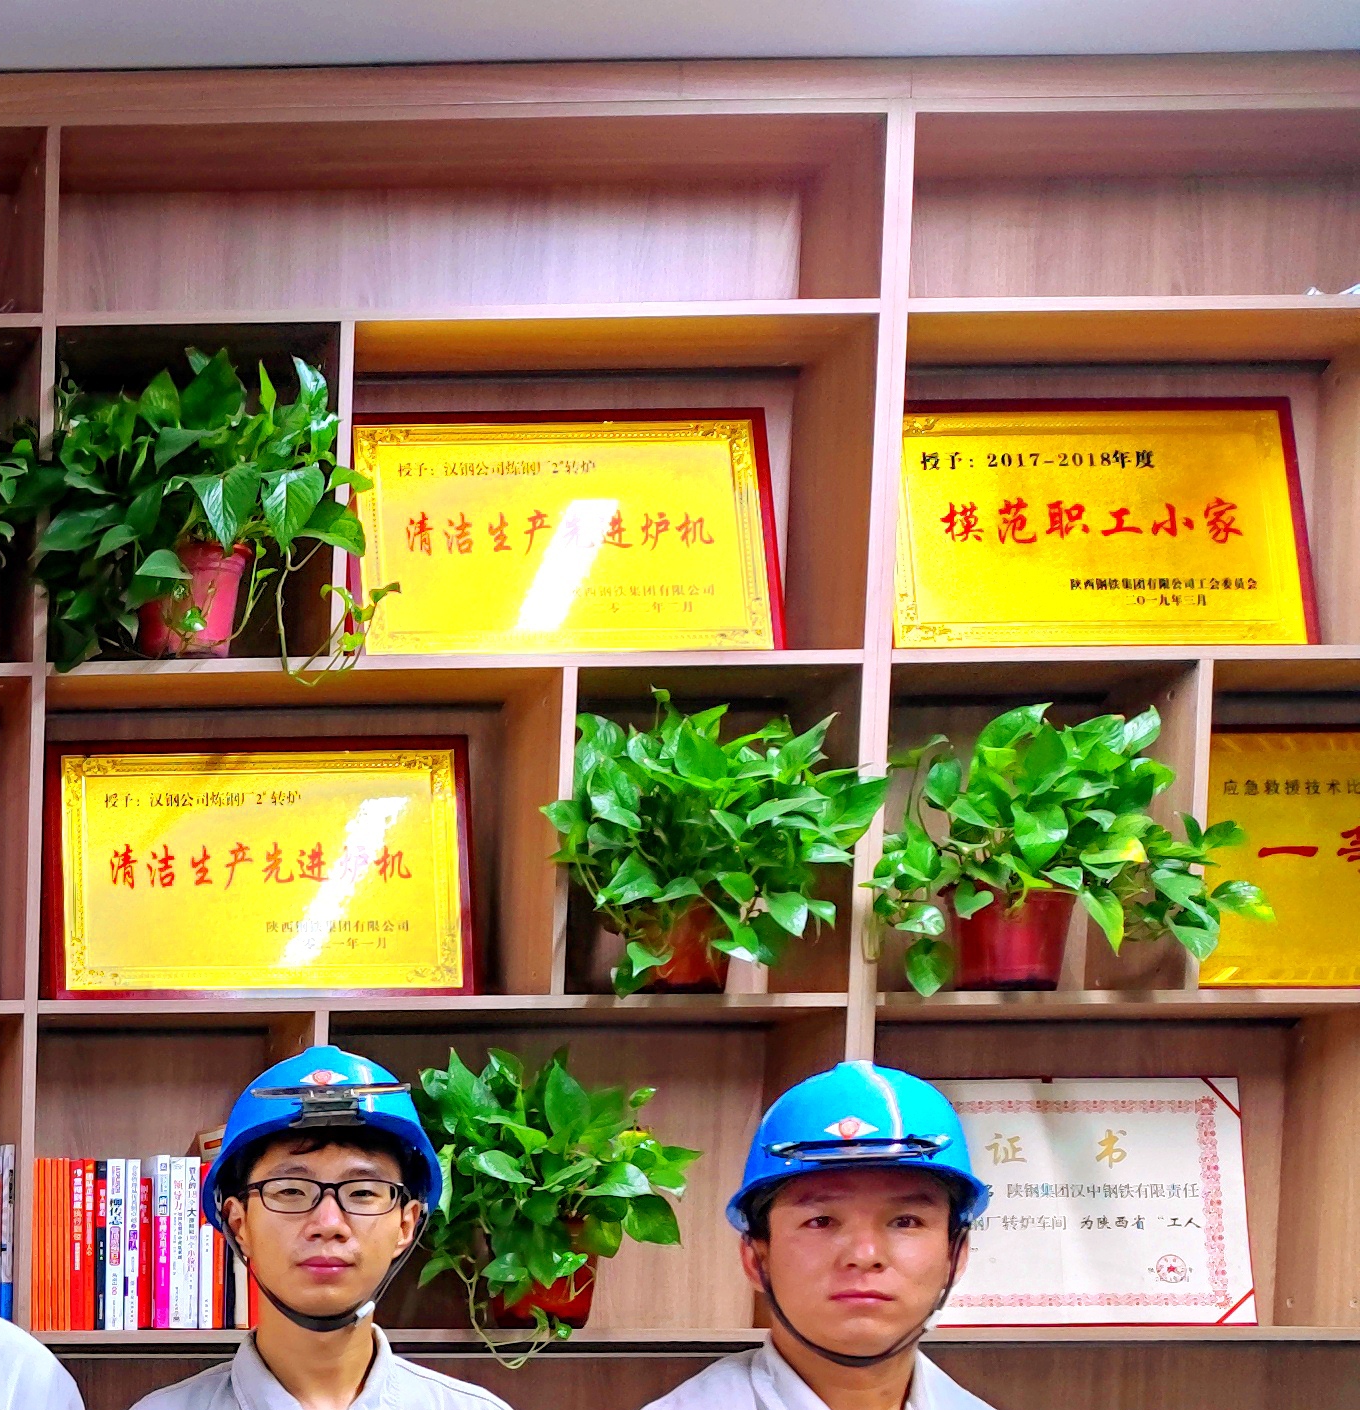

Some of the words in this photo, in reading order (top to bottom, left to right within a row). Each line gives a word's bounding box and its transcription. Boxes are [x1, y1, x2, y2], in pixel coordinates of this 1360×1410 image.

[406, 509, 715, 556] 清洁生产先进炉机
[940, 497, 1244, 545] 模范职工小家
[110, 841, 413, 890] 清洁生产先进炉机
[984, 1129, 1129, 1169] 证书
